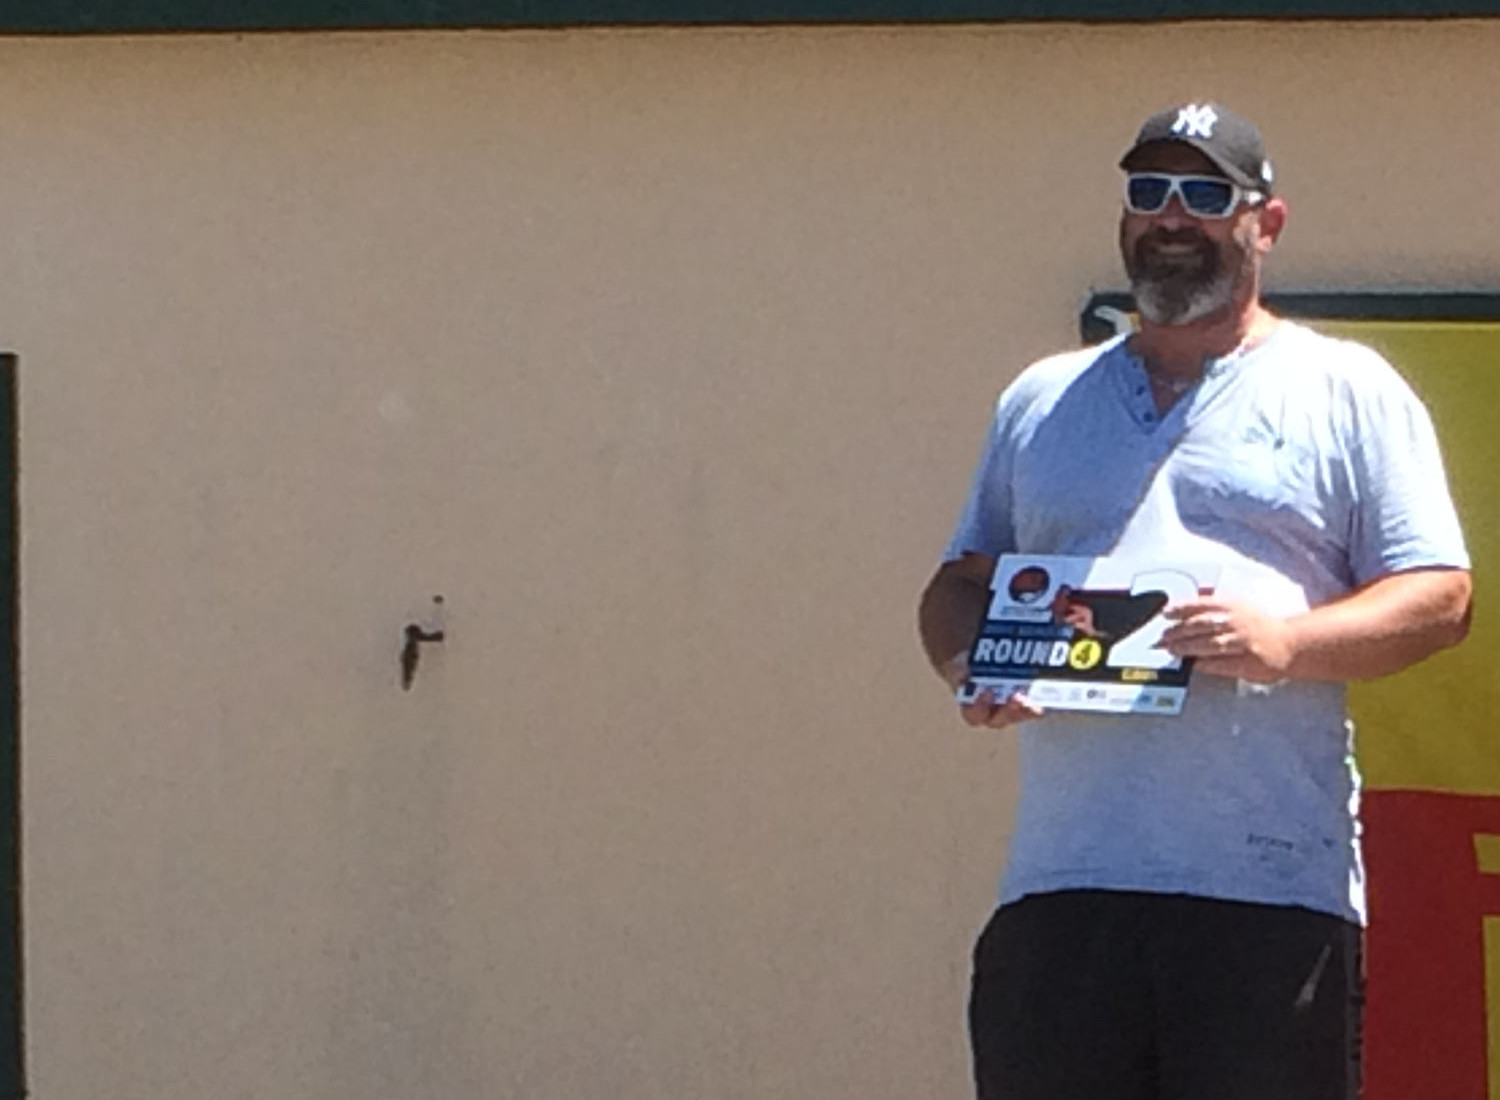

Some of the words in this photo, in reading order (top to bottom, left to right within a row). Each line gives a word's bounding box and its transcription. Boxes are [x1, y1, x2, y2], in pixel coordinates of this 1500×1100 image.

[1170, 104, 1218, 138] NY
[1105, 568, 1199, 671] 2
[973, 638, 1070, 666] ROUND
